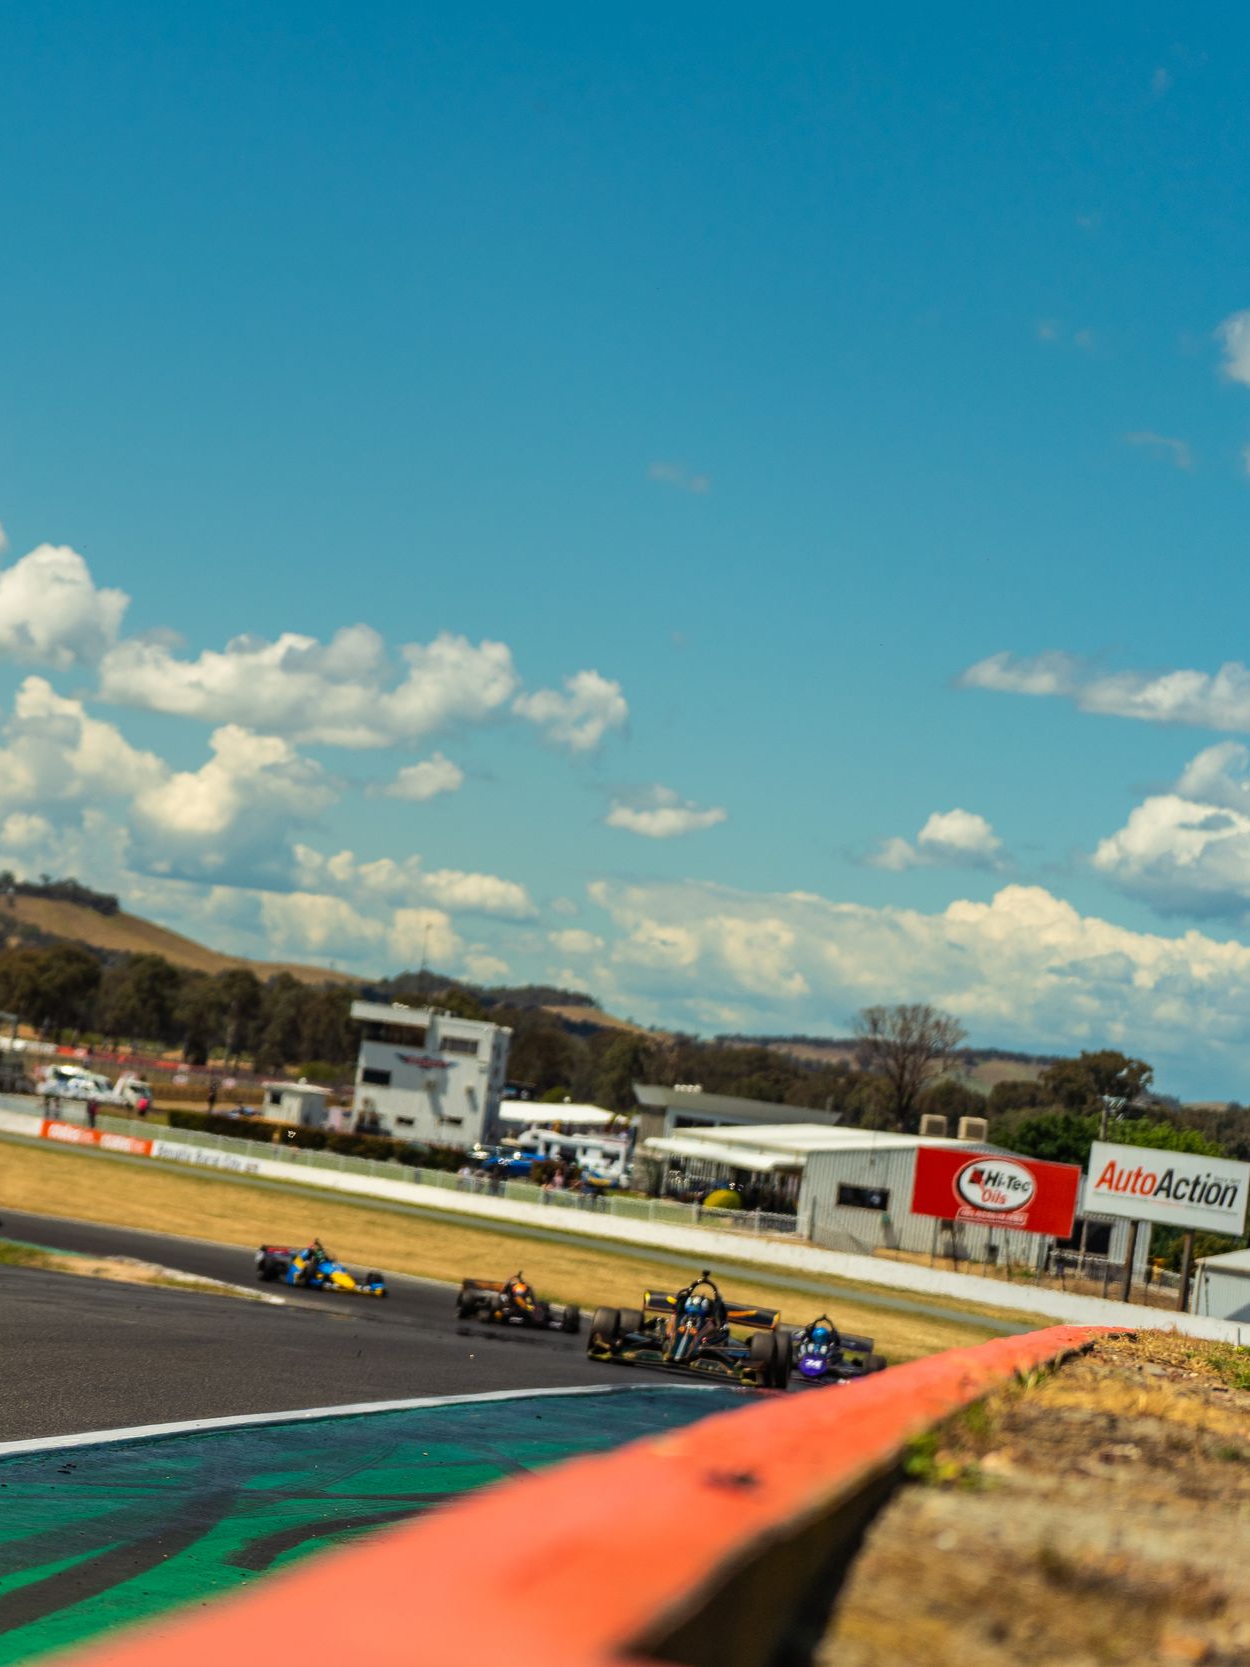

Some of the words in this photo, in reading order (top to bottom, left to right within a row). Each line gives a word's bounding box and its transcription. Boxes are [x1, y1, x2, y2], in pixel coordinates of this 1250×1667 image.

[984, 1169, 1031, 1192] Hi-Tec
[1094, 1159, 1238, 1208] AutoAction
[981, 1189, 1007, 1205] Oils
